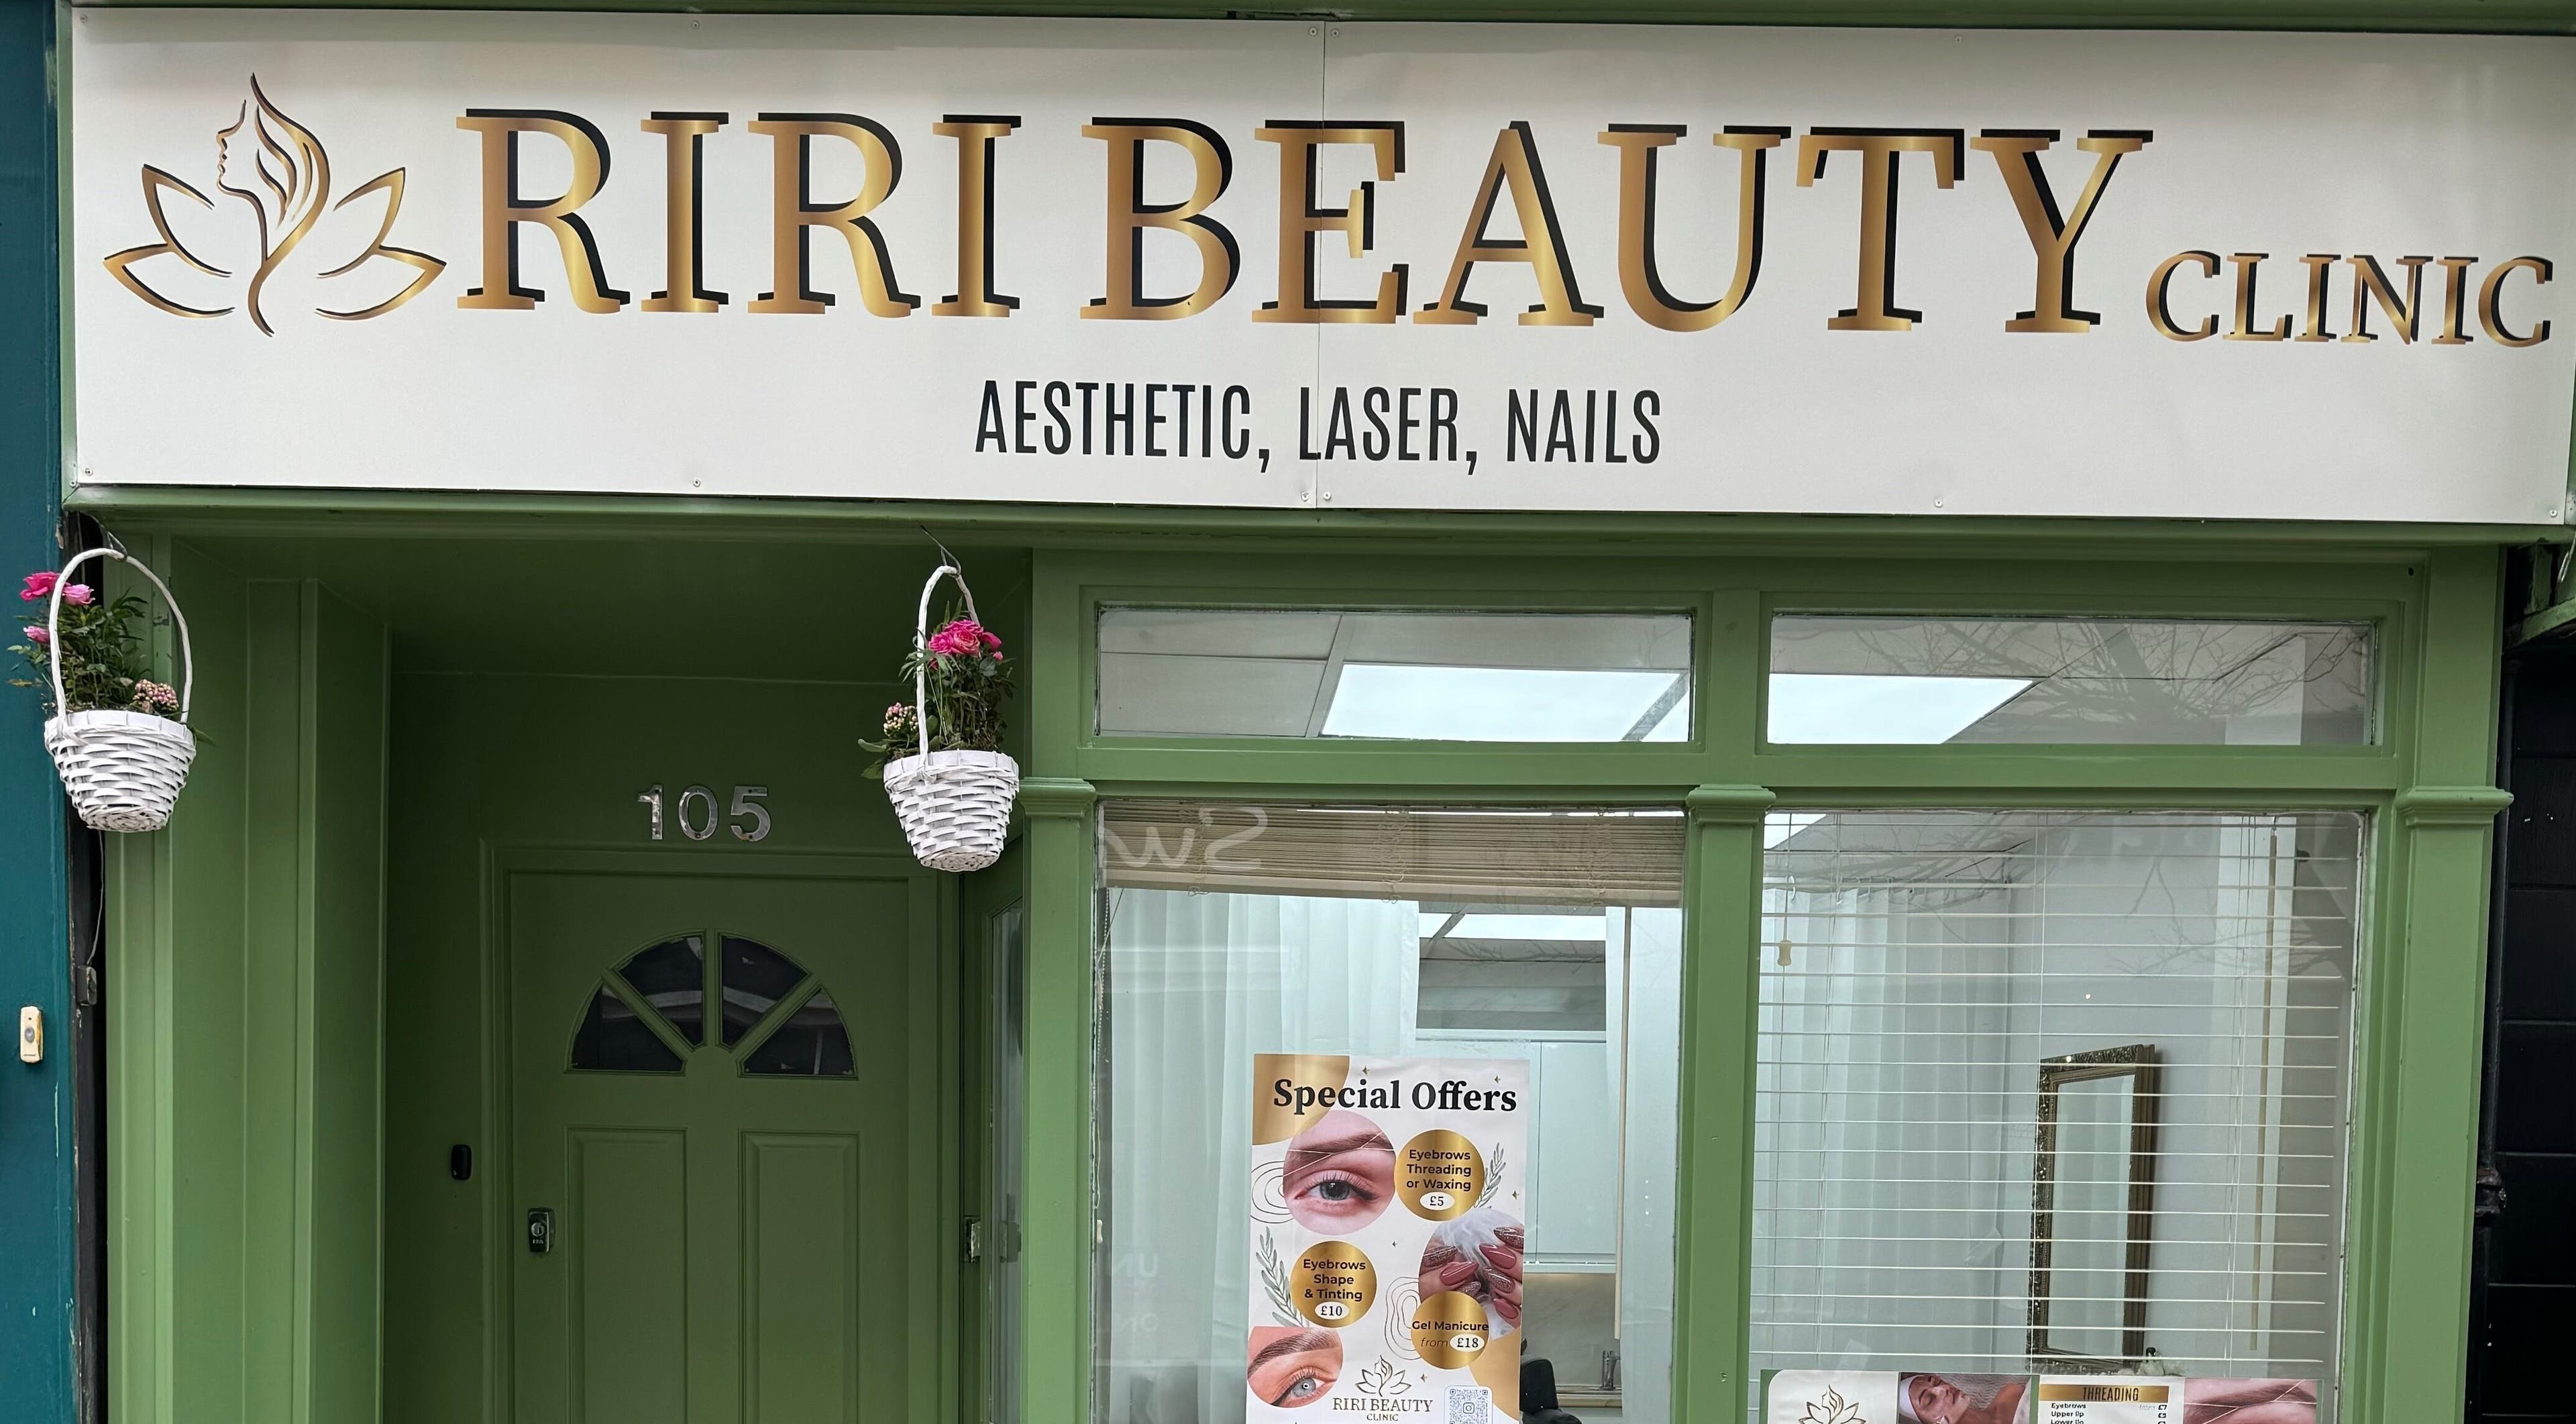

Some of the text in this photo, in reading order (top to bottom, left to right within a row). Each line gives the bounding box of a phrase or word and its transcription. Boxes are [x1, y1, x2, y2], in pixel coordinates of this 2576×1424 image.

[456, 109, 2553, 347] RIRI BEAUTY CLINIC
[975, 380, 1660, 475] AESTHETIC, LASER, NAILS
[638, 785, 771, 842] 105
[1274, 1079, 1517, 1115] Special Offers
[1409, 1150, 1470, 1161] Eyebrows
[1407, 1164, 1471, 1177] Threading
[1423, 1179, 1471, 1191] Waxing
[1430, 1196, 1444, 1206] £5
[1303, 1259, 1366, 1270] Eyebrows
[1313, 1274, 1354, 1286] Shape
[1305, 1289, 1362, 1302] & Tinting
[1321, 1306, 1342, 1316] £10
[1412, 1321, 1489, 1331] Gel Manicure
[1421, 1337, 1479, 1348] from £18
[2083, 1386, 2139, 1401] THREADING
[1333, 1398, 1433, 1412] RIRI BEAUTY
[1366, 1413, 1399, 1421] CLINIC
